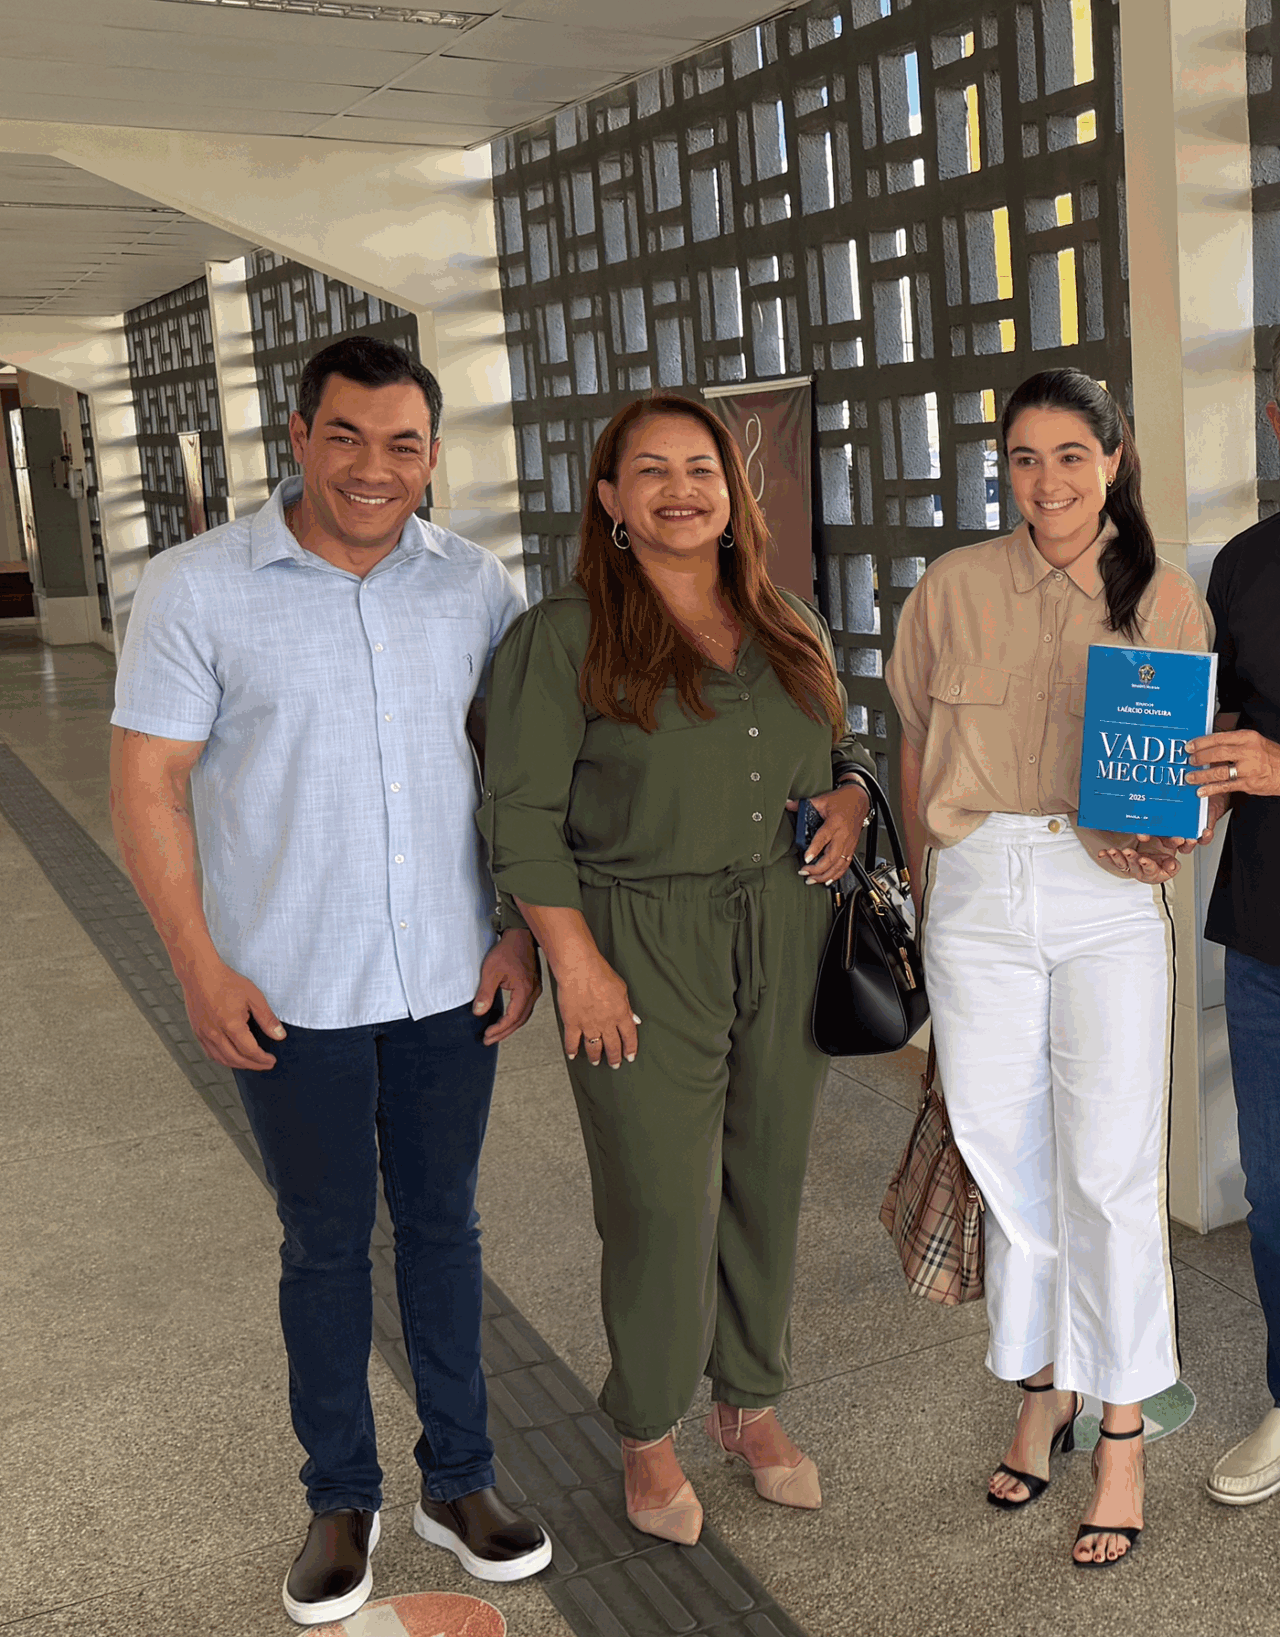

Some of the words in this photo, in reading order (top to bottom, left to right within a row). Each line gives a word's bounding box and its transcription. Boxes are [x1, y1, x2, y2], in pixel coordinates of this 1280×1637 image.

[1098, 730, 1188, 765] VADE
[1096, 759, 1187, 787] MECUM
[1128, 793, 1147, 802] 2025
